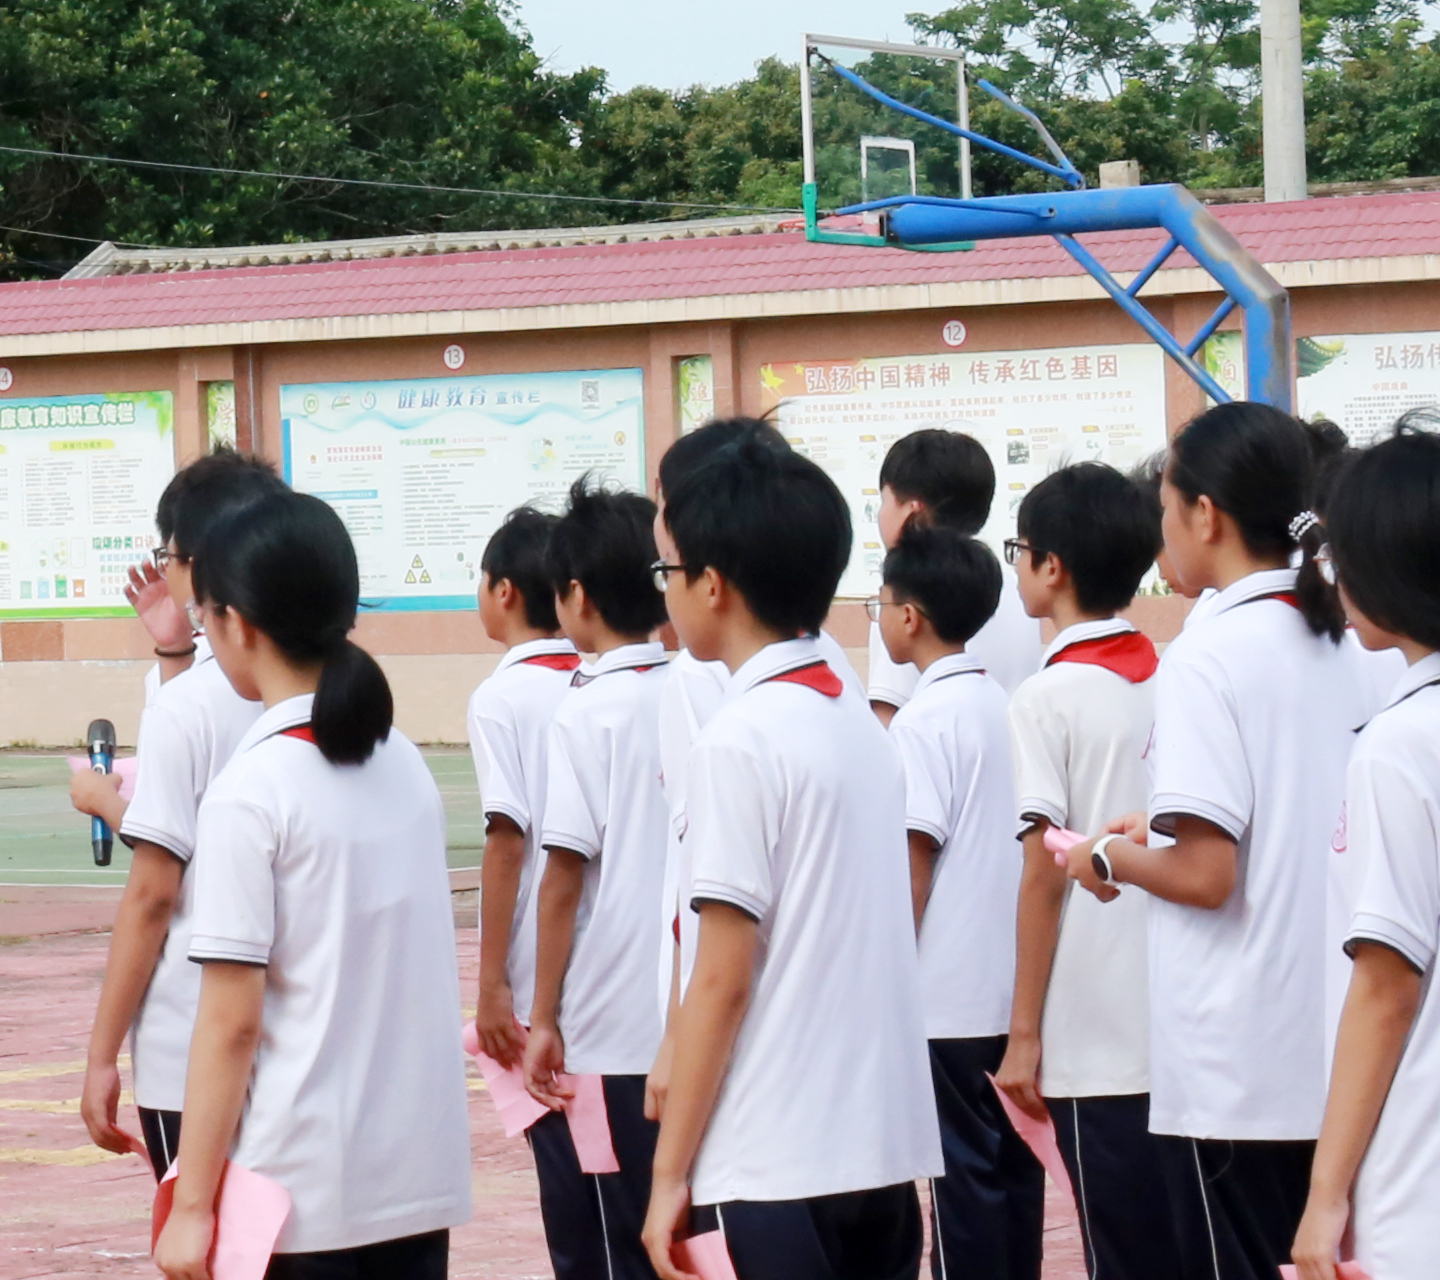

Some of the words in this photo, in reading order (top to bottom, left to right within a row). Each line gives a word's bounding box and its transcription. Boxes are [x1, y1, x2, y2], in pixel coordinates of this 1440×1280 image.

[946, 325, 962, 341] 12
[447, 349, 461, 363] 13
[806, 362, 951, 393] 弘扬中国精神
[969, 354, 1119, 383] 传承红色基因
[398, 386, 488, 410] 健康教育
[495, 390, 541, 406] 宣传栏
